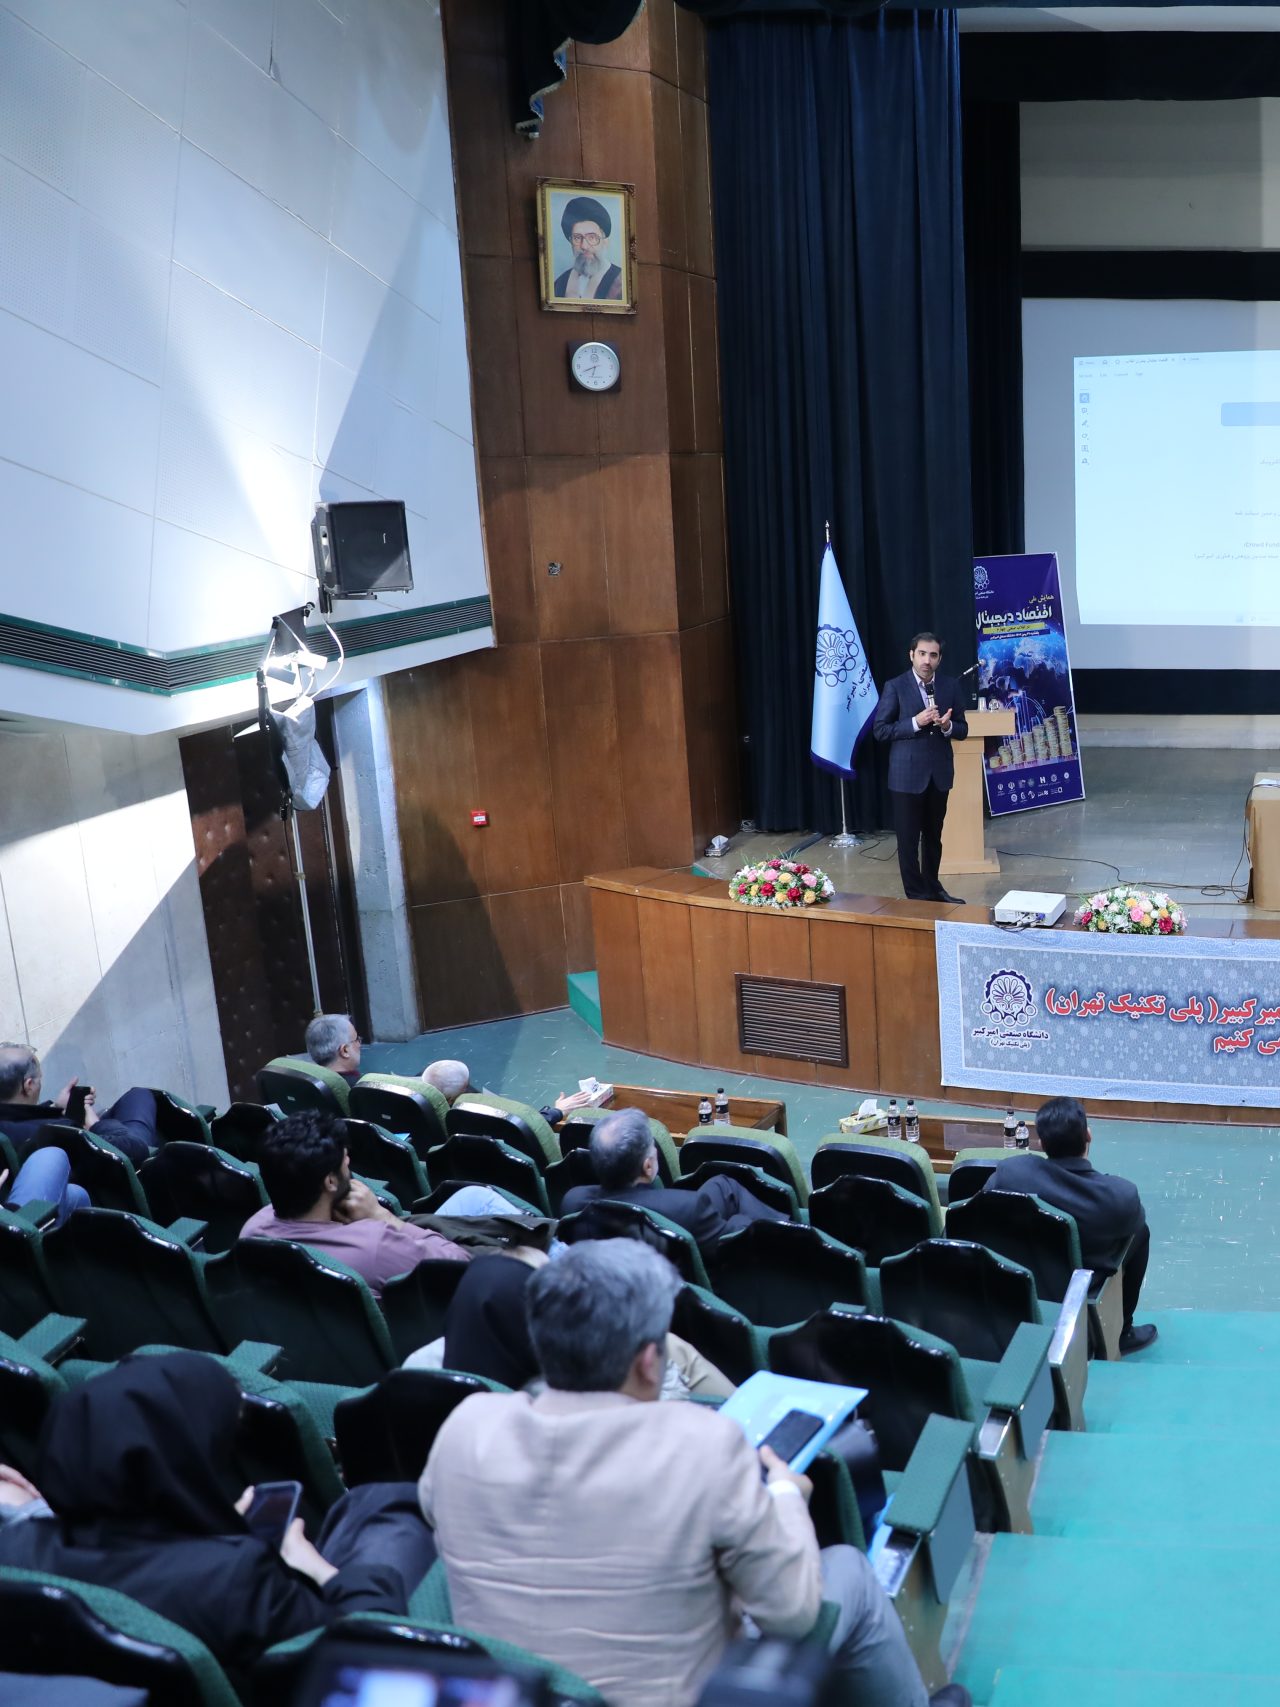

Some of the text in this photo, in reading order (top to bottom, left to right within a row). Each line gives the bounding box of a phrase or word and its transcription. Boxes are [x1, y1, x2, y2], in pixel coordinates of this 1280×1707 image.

[1029, 594, 1054, 604] همایش ملی
[975, 604, 1052, 630] اقتصاد دیجیتال
[1045, 988, 1105, 1015] تهران)
[1108, 993, 1166, 1019] تکنیک
[1169, 997, 1203, 1024] پلی
[1000, 1030, 1021, 1040] صنعتی
[1023, 1030, 1049, 1039] دانشگاه
[1214, 1028, 1255, 1053] کنیم
